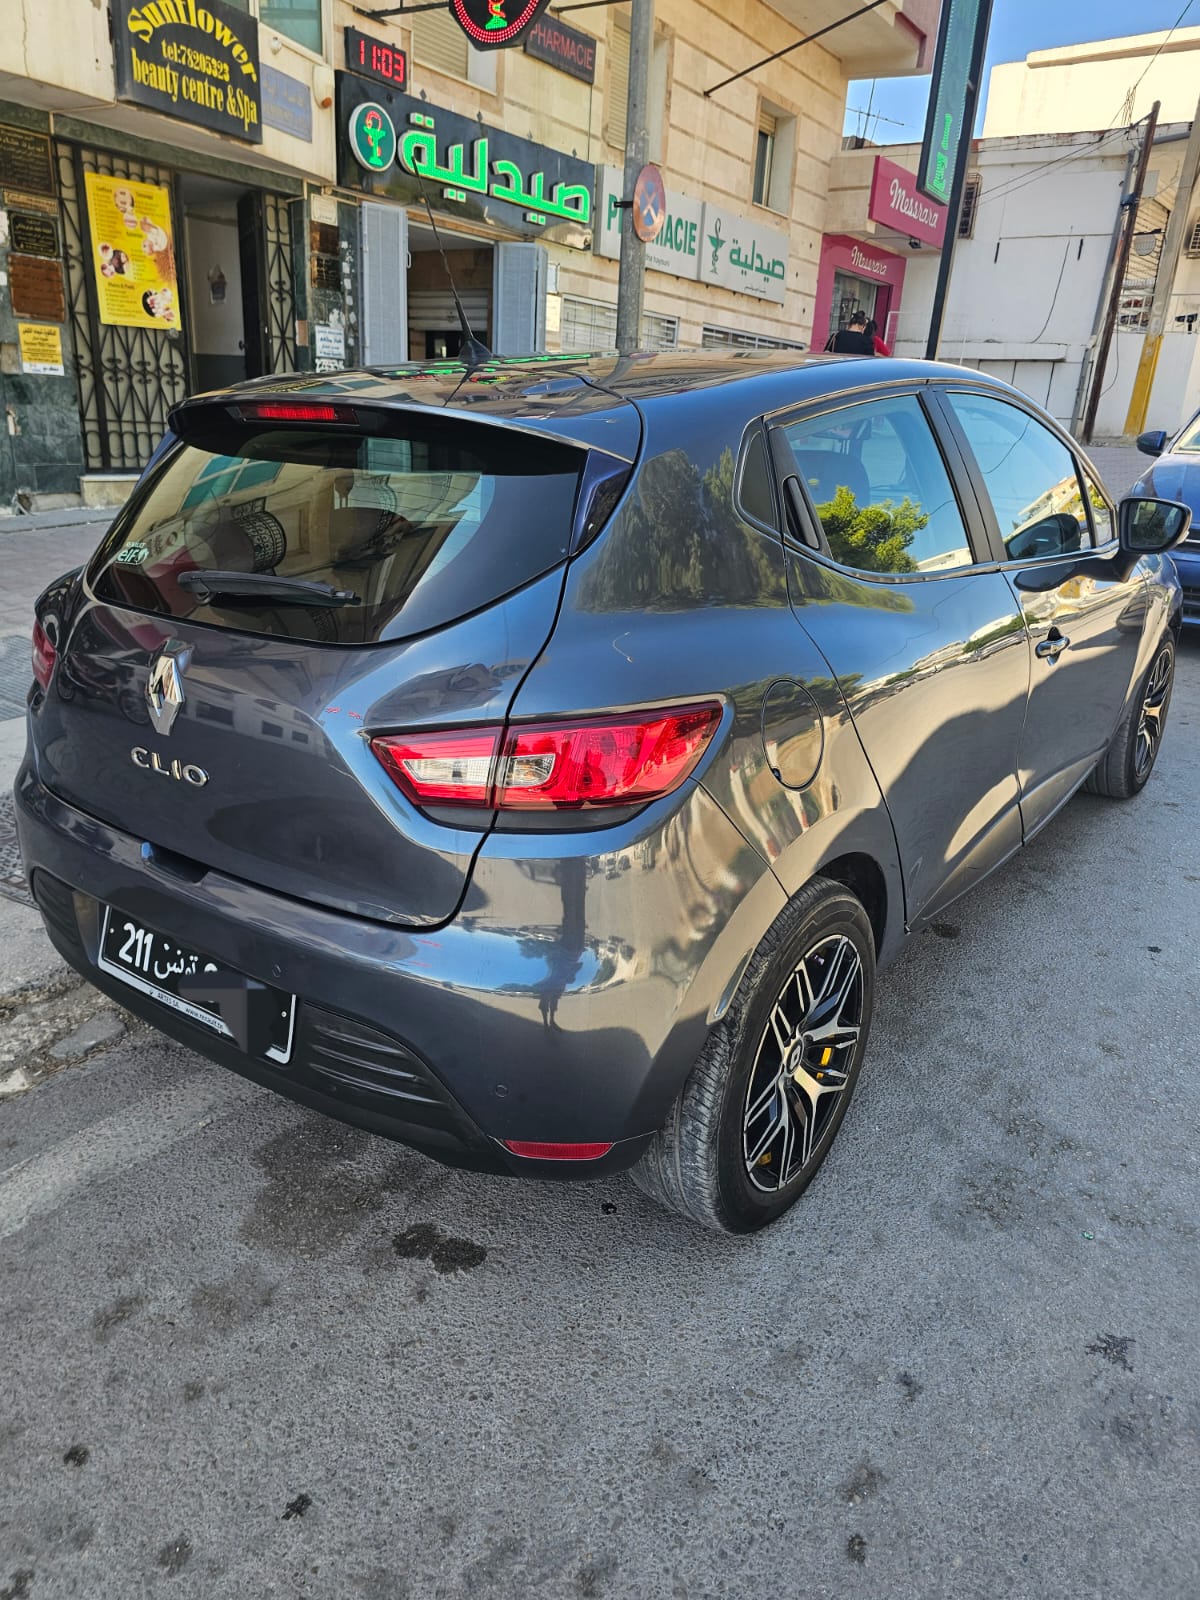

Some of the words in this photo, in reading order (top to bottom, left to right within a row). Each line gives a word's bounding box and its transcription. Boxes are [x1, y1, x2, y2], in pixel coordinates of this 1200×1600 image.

[127, 0, 257, 83] Sunflower
[360, 38, 405, 83] 11:03
[131, 47, 179, 103] beauty
[182, 75, 224, 112] centre
[226, 84, 258, 132] &Spa
[399, 112, 590, 226] صيدلية
[729, 238, 785, 283] صيدلية
[130, 746, 209, 787] CLIO
[119, 922, 154, 972] 211
